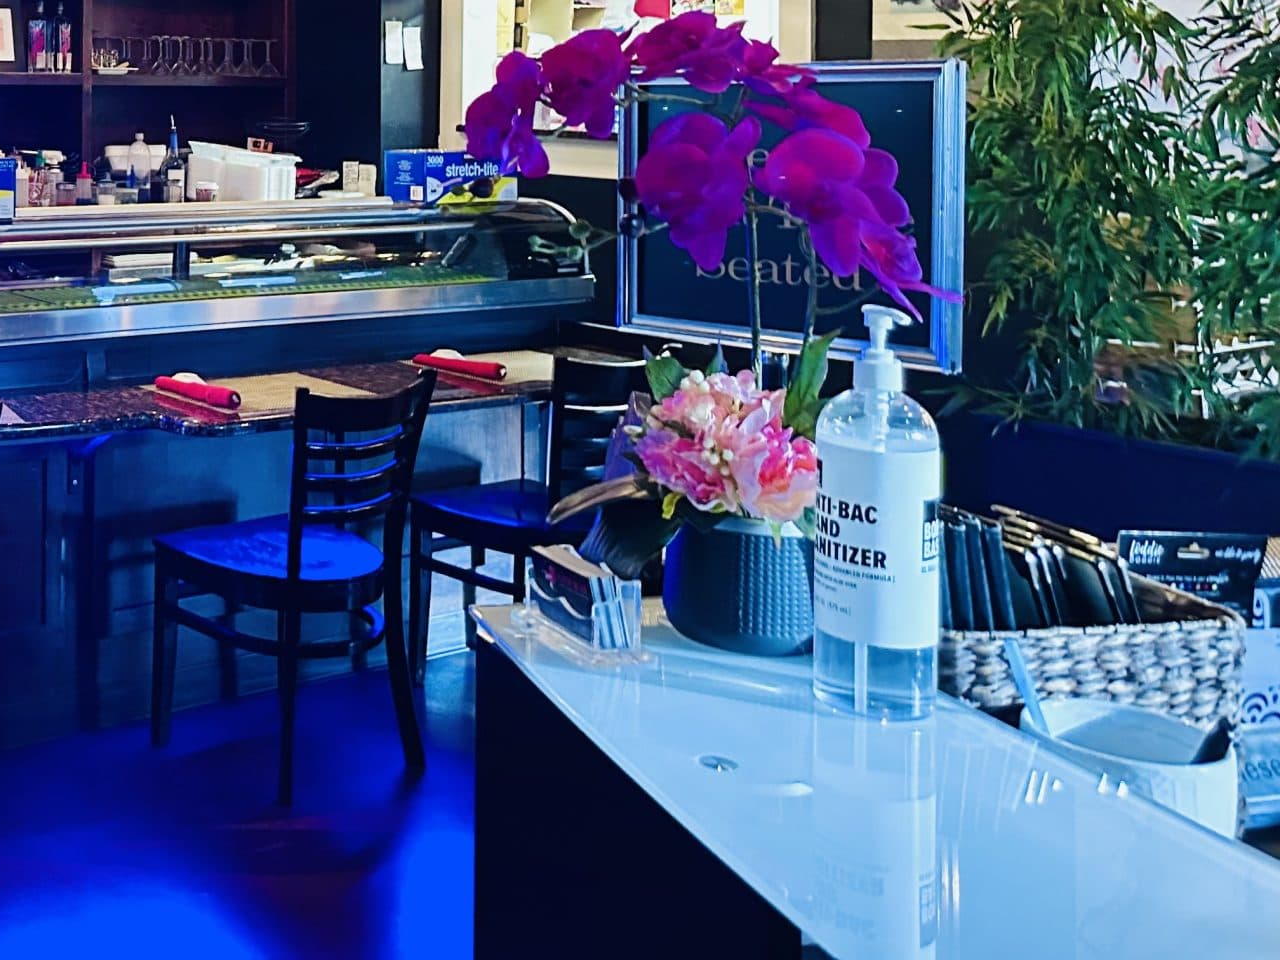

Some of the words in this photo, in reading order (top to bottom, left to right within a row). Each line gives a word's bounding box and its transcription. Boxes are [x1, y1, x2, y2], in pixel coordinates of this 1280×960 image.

[445, 161, 499, 177] stretch-tite
[816, 494, 877, 524] NTI-BAC
[816, 513, 840, 538] AND
[815, 536, 886, 569] ANITIZER
